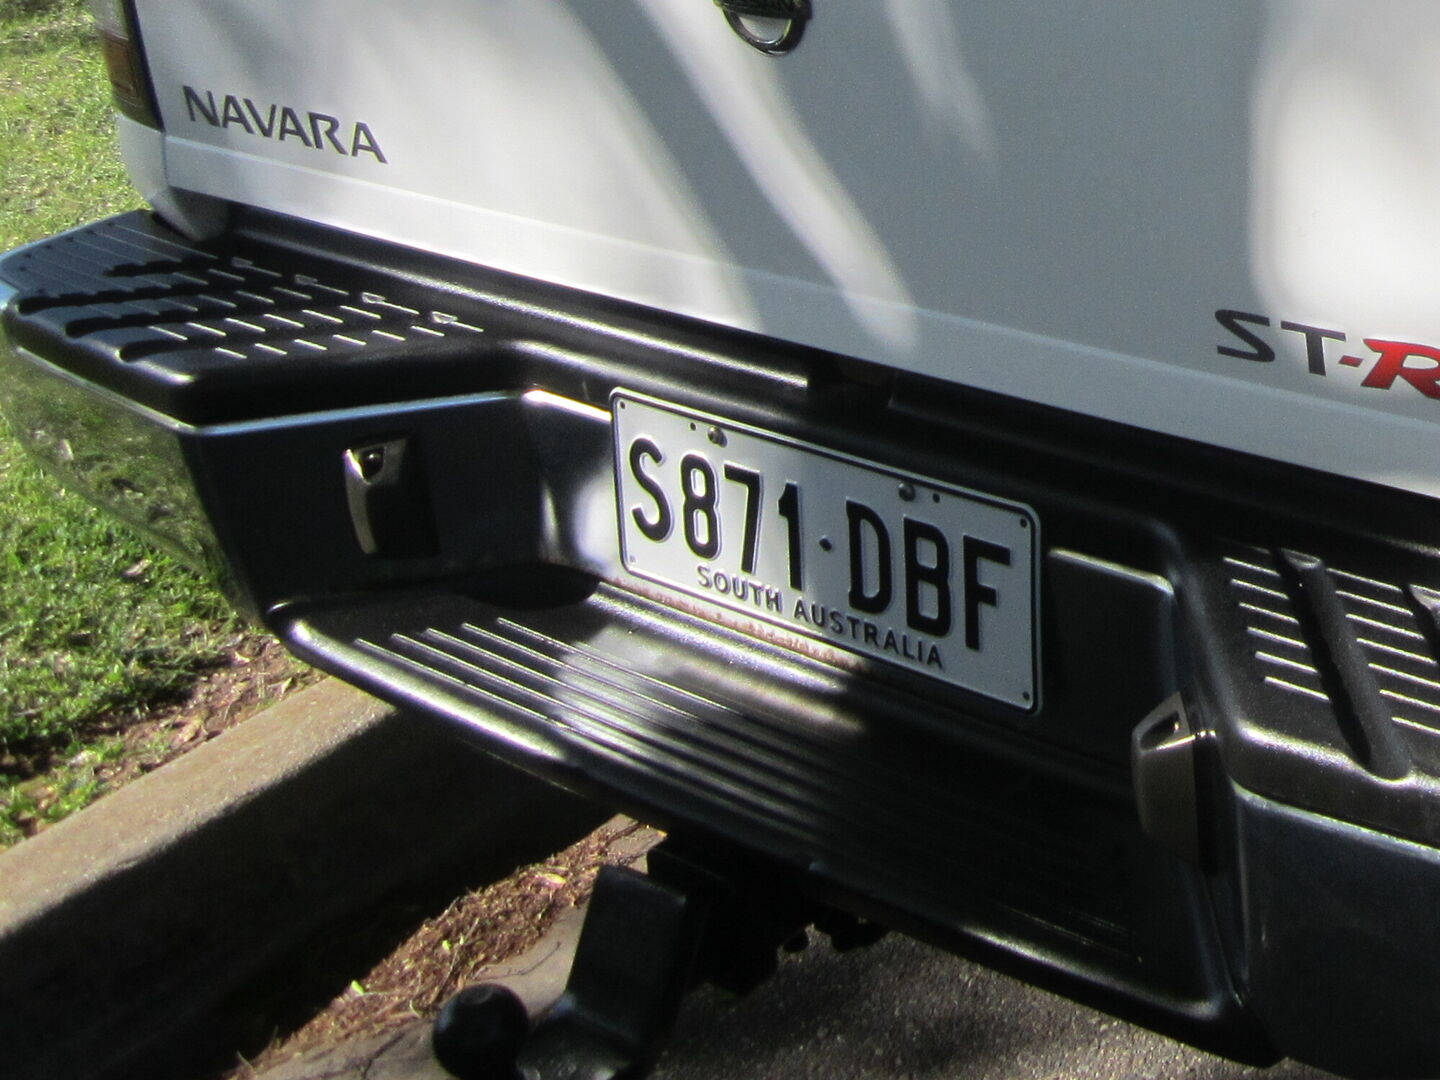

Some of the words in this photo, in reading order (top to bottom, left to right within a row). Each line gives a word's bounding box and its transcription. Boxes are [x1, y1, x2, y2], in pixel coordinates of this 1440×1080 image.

[182, 85, 388, 165] NAVARA
[697, 565, 783, 613] SOUTH
[794, 599, 945, 671] AUSTRALIA
